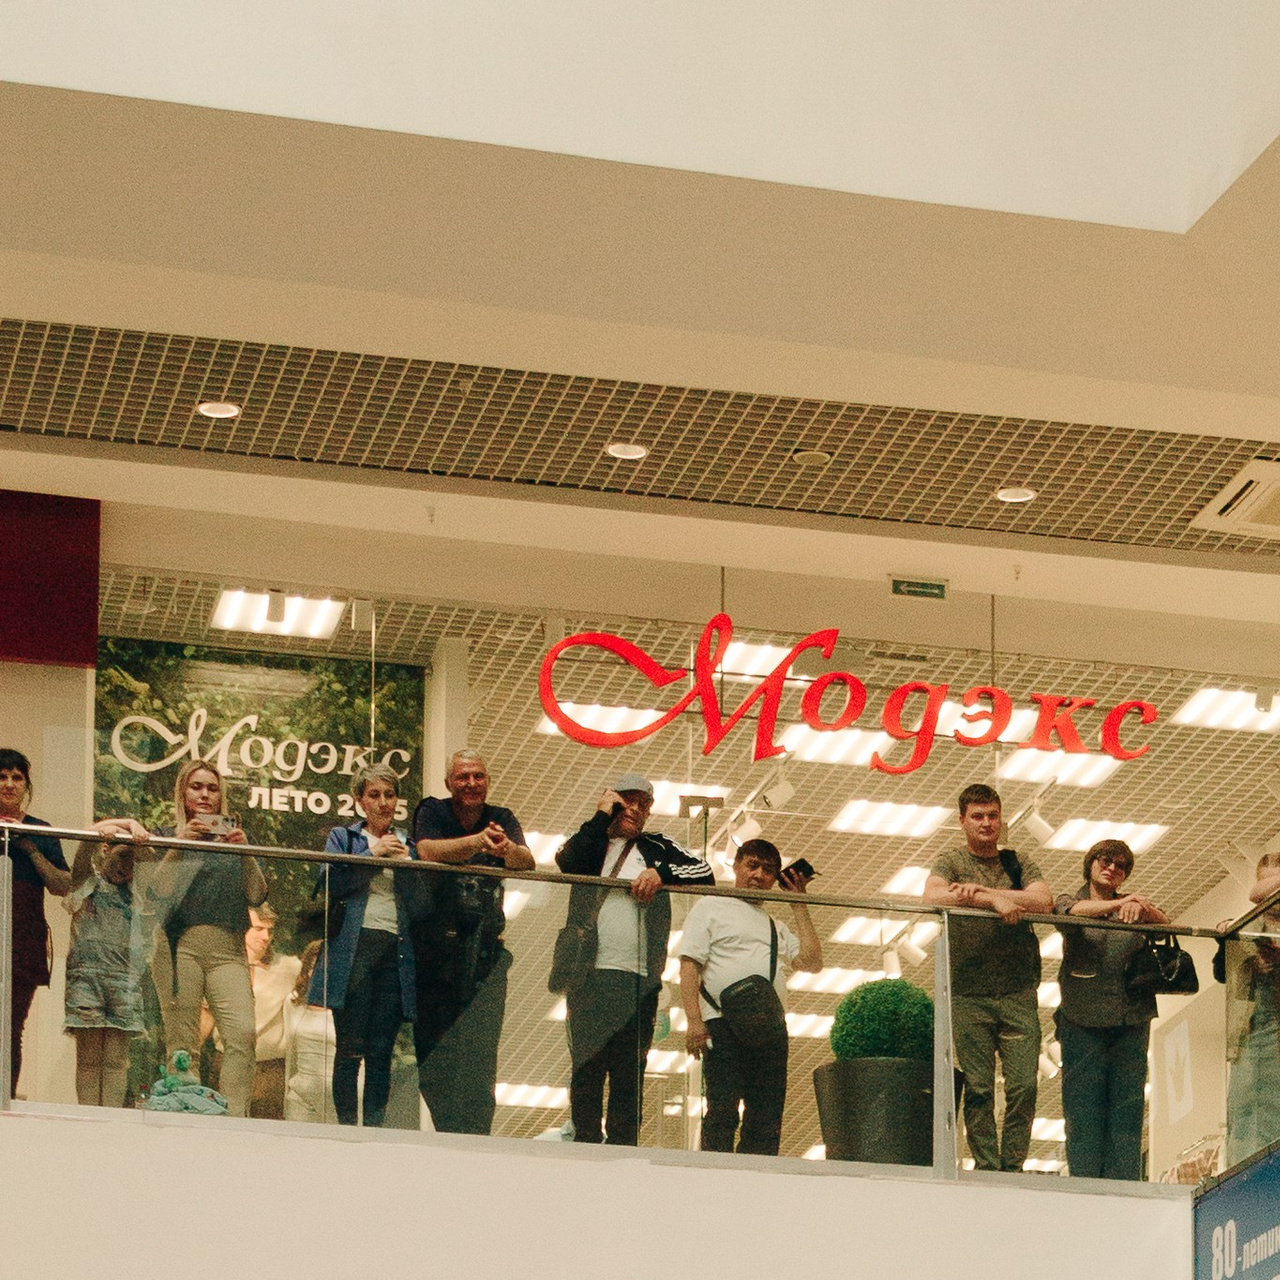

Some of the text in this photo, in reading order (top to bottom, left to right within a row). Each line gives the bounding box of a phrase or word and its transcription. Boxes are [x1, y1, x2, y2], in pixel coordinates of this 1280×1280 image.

[539, 612, 1159, 775] Модэкс
[111, 708, 411, 782] Модэкс
[248, 786, 409, 821] ЛЕТО 25
